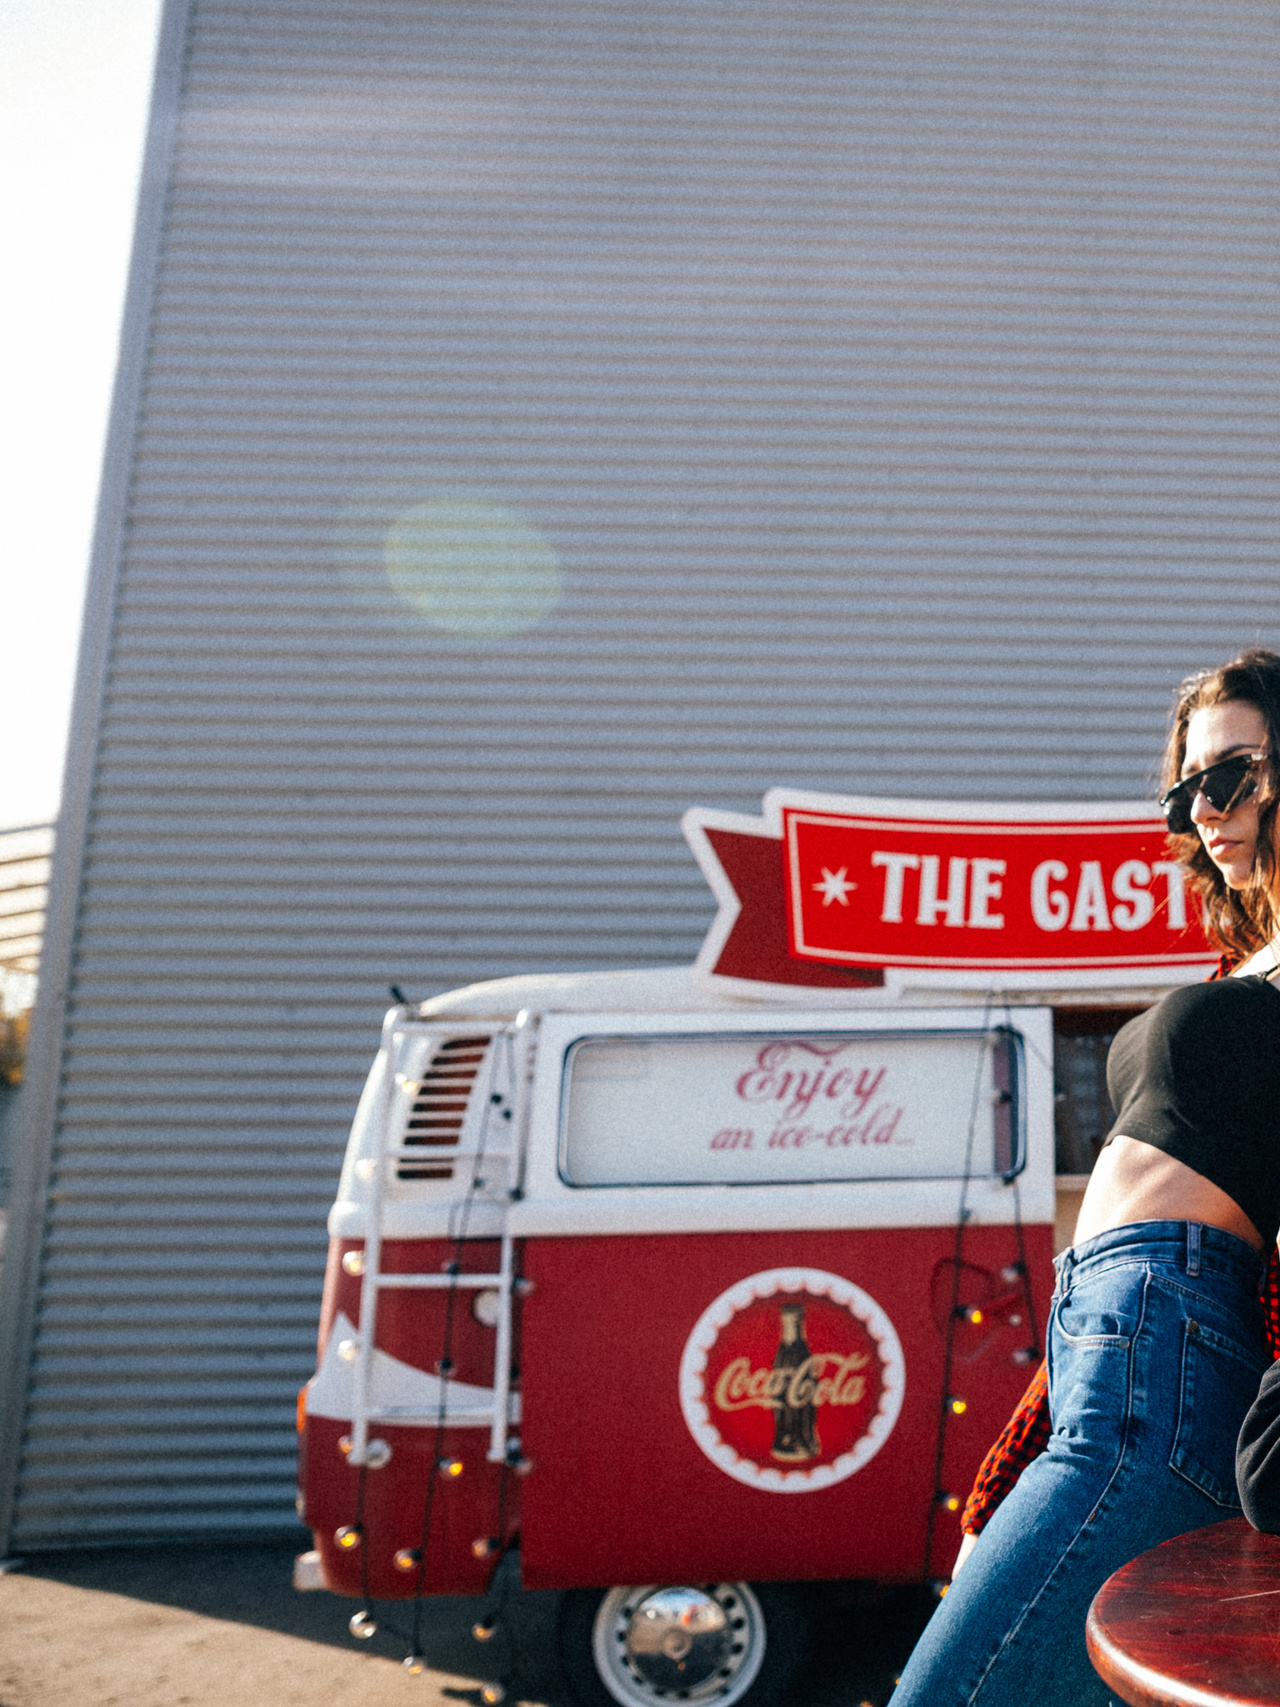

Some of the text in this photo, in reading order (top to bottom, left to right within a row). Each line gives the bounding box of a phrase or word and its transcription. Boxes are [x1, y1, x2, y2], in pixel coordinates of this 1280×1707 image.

[872, 851, 1229, 932] THE GAST
[737, 1040, 888, 1120] Enjoy
[710, 1127, 755, 1151] an
